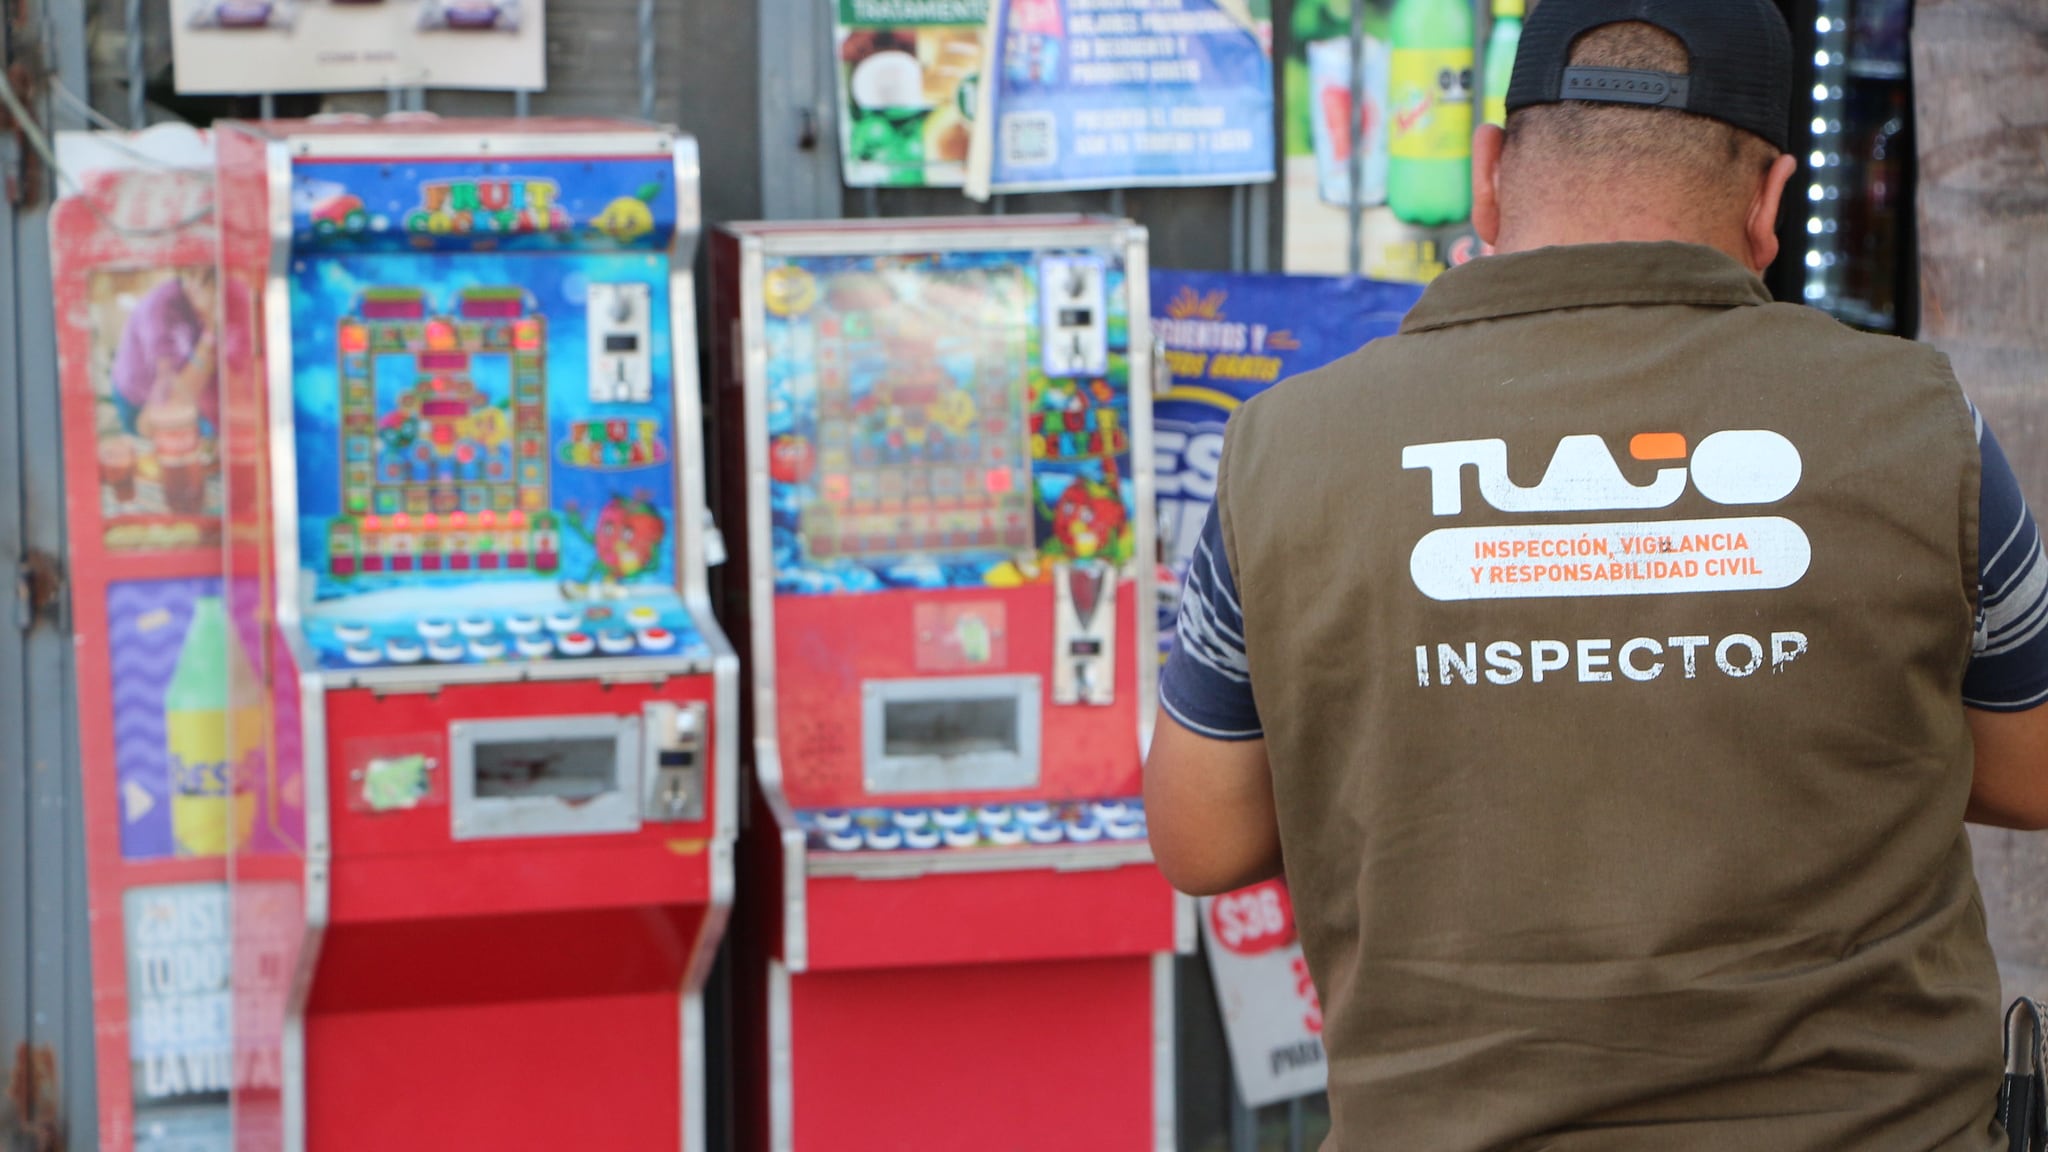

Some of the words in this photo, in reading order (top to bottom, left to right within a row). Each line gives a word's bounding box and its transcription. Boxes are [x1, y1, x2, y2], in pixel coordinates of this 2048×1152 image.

[423, 181, 558, 212] FRUIT
[1250, 322, 1268, 355] Y
[571, 418, 657, 443] FRUIT
[1474, 533, 1614, 560] INSPECCIÓN,
[1620, 532, 1749, 556] VIGILANCIA
[1470, 565, 1483, 584] Y
[1489, 559, 1699, 583] RESPONSABILIDAD
[1704, 557, 1762, 577] CIVIL
